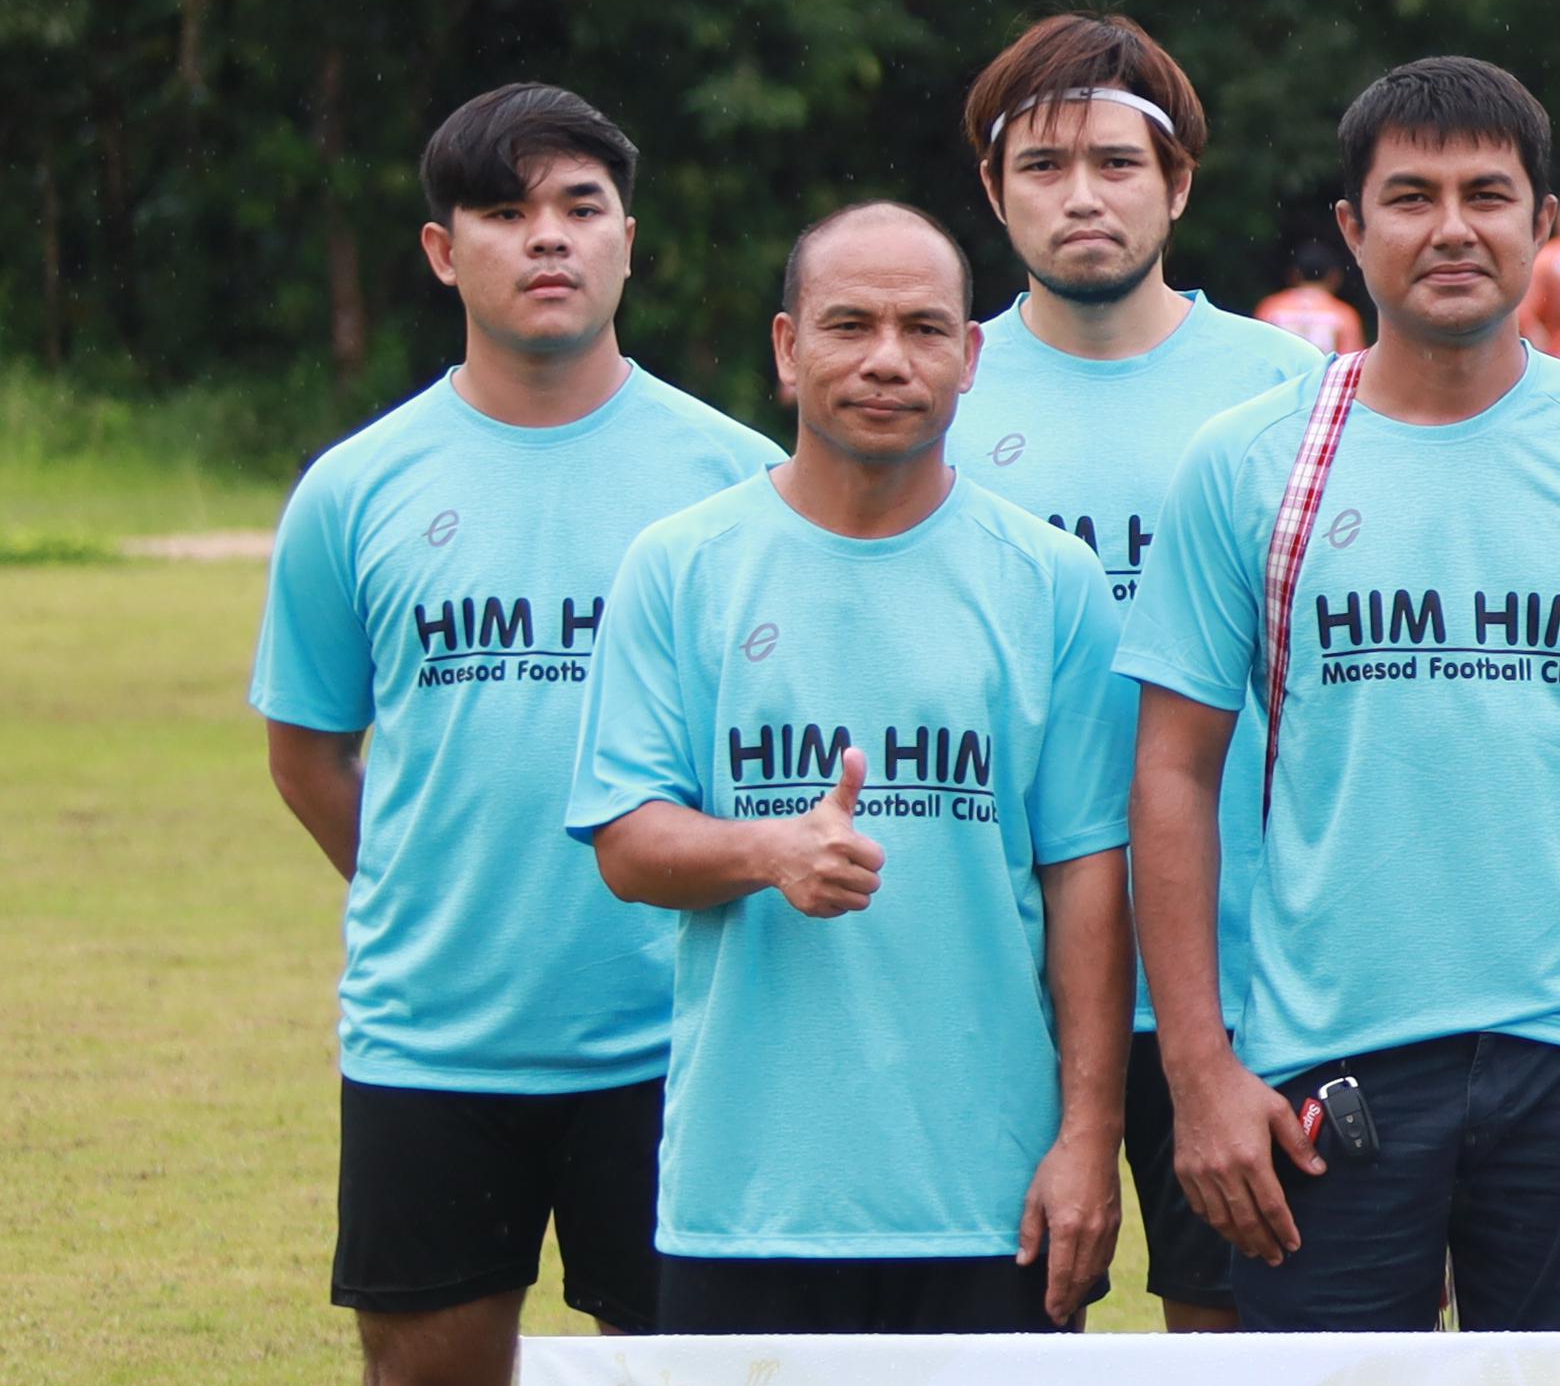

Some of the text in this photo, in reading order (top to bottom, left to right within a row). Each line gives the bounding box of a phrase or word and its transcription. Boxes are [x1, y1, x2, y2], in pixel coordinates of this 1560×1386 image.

[414, 596, 534, 654] HIM
[1316, 589, 1447, 649] HIM
[418, 660, 589, 688] Maesod Footb
[1322, 656, 1417, 685] Maesod
[1430, 657, 1532, 680] Football
[729, 724, 851, 782] HIM
[855, 794, 940, 817] ootball
